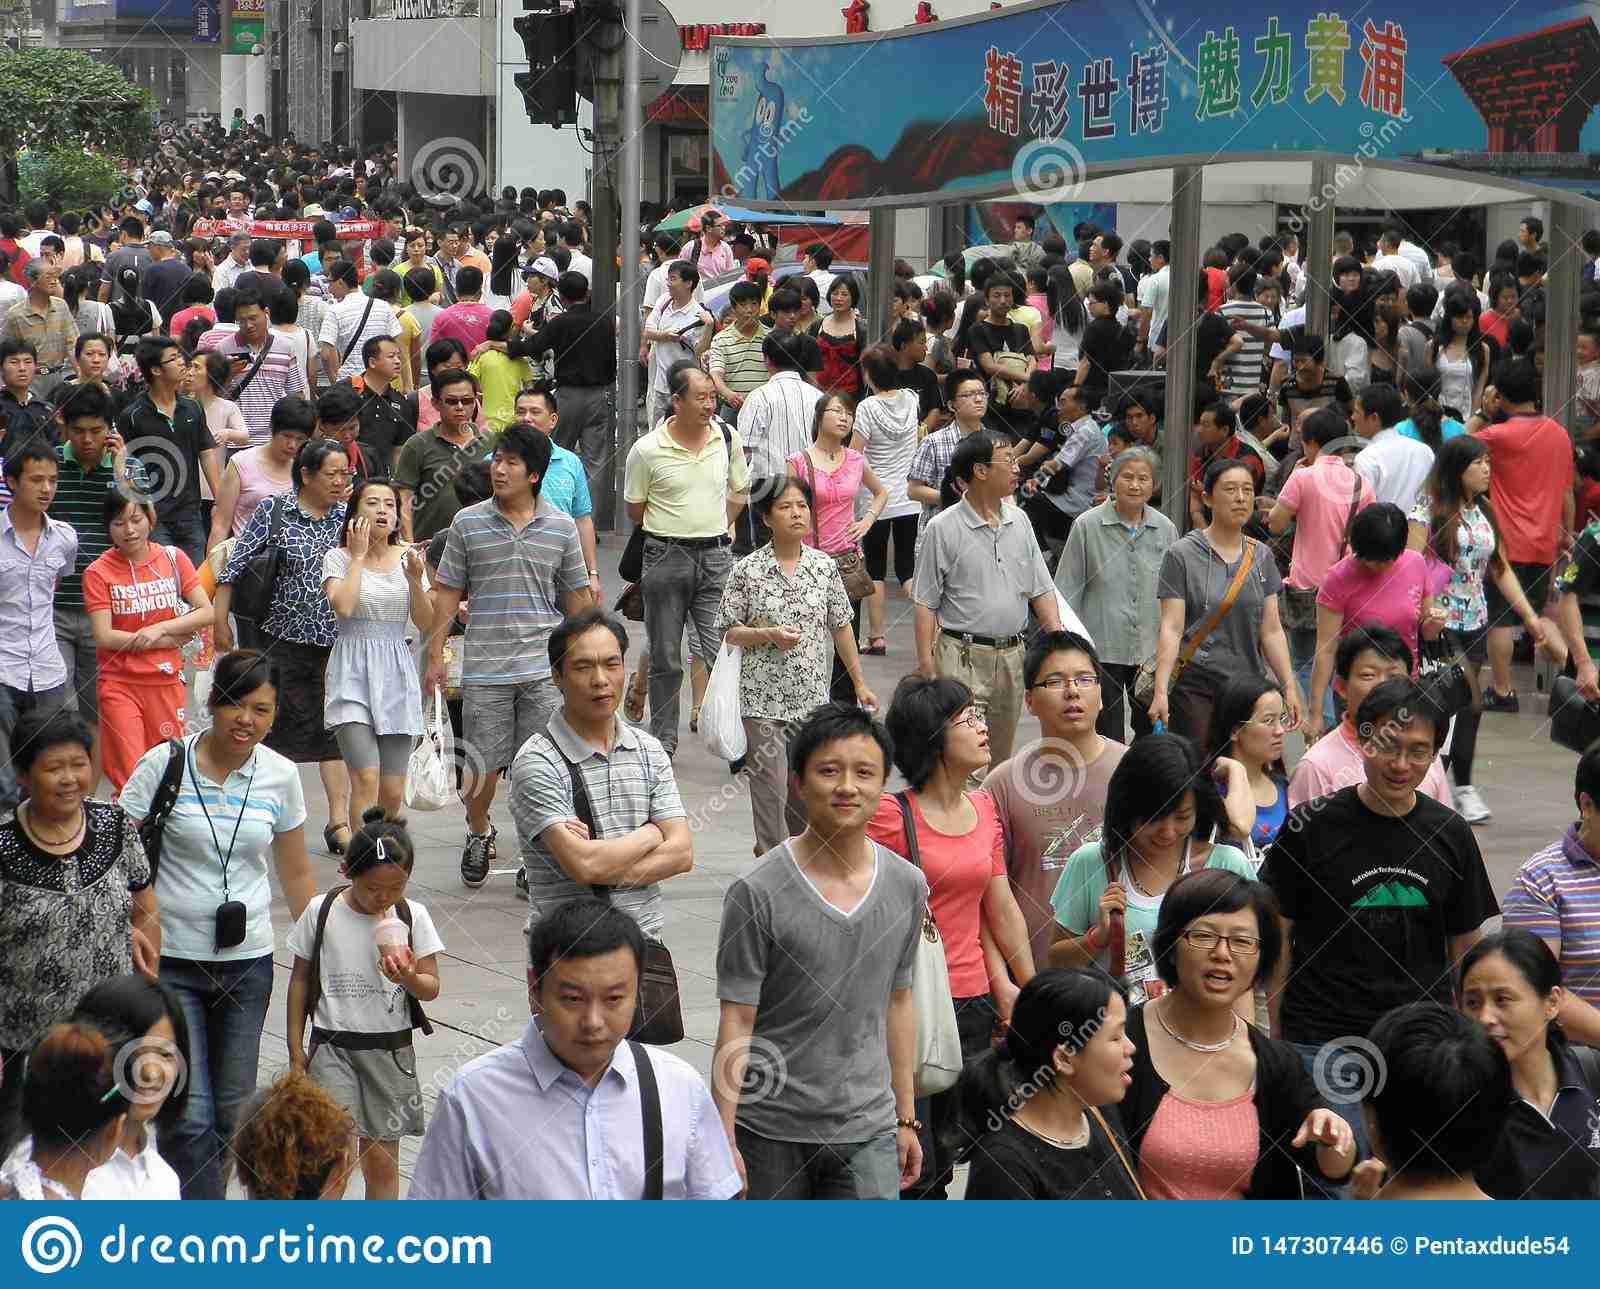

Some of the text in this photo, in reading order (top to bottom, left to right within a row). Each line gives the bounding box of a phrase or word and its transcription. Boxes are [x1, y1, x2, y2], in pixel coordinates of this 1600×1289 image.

[983, 12, 1408, 144] 精彩世博 魅力黄浦
